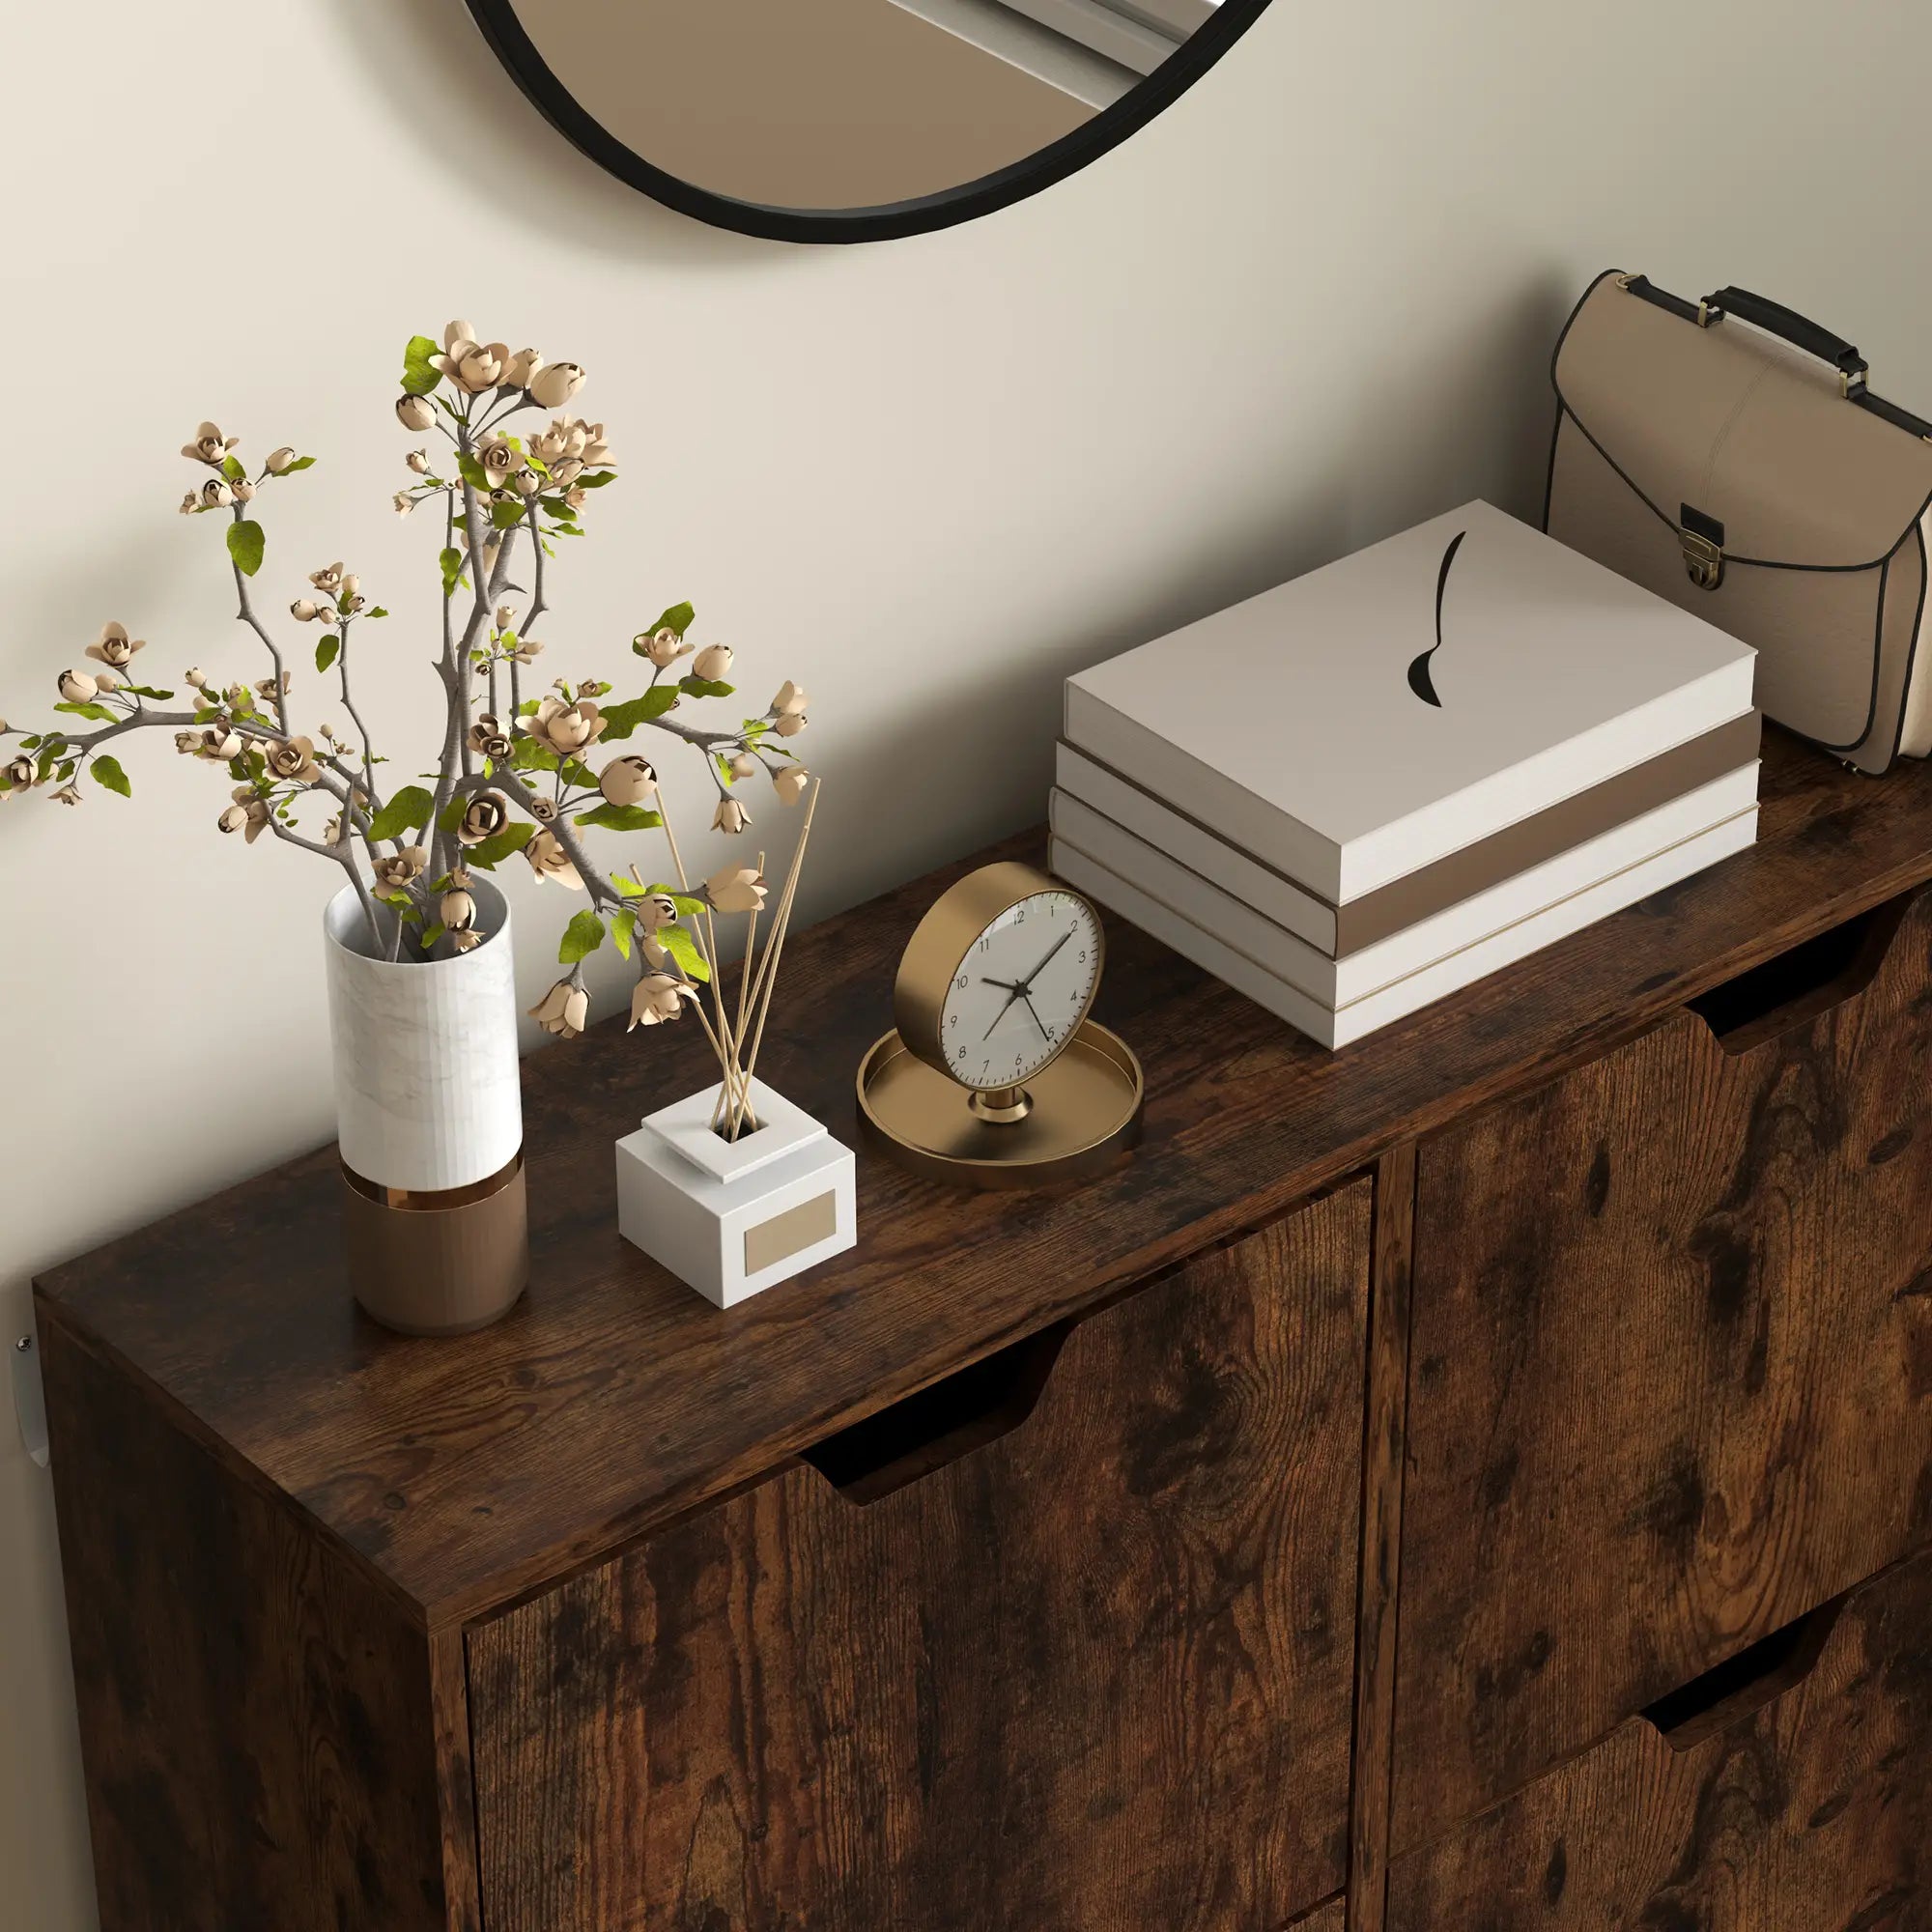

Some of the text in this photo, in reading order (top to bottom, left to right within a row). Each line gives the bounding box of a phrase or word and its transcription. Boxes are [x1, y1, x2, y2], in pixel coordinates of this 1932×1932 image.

[1013, 910, 1025, 925] 12
[1069, 920, 1079, 933] 2
[980, 938, 990, 952] 11
[1078, 951, 1086, 963] 3
[956, 975, 969, 990] 10
[1070, 989, 1078, 1002] 4
[950, 1015, 958, 1028] 9
[1047, 1026, 1055, 1039] 5
[958, 1046, 967, 1059] 8
[1014, 1053, 1022, 1065] 6
[982, 1059, 990, 1073] 7
